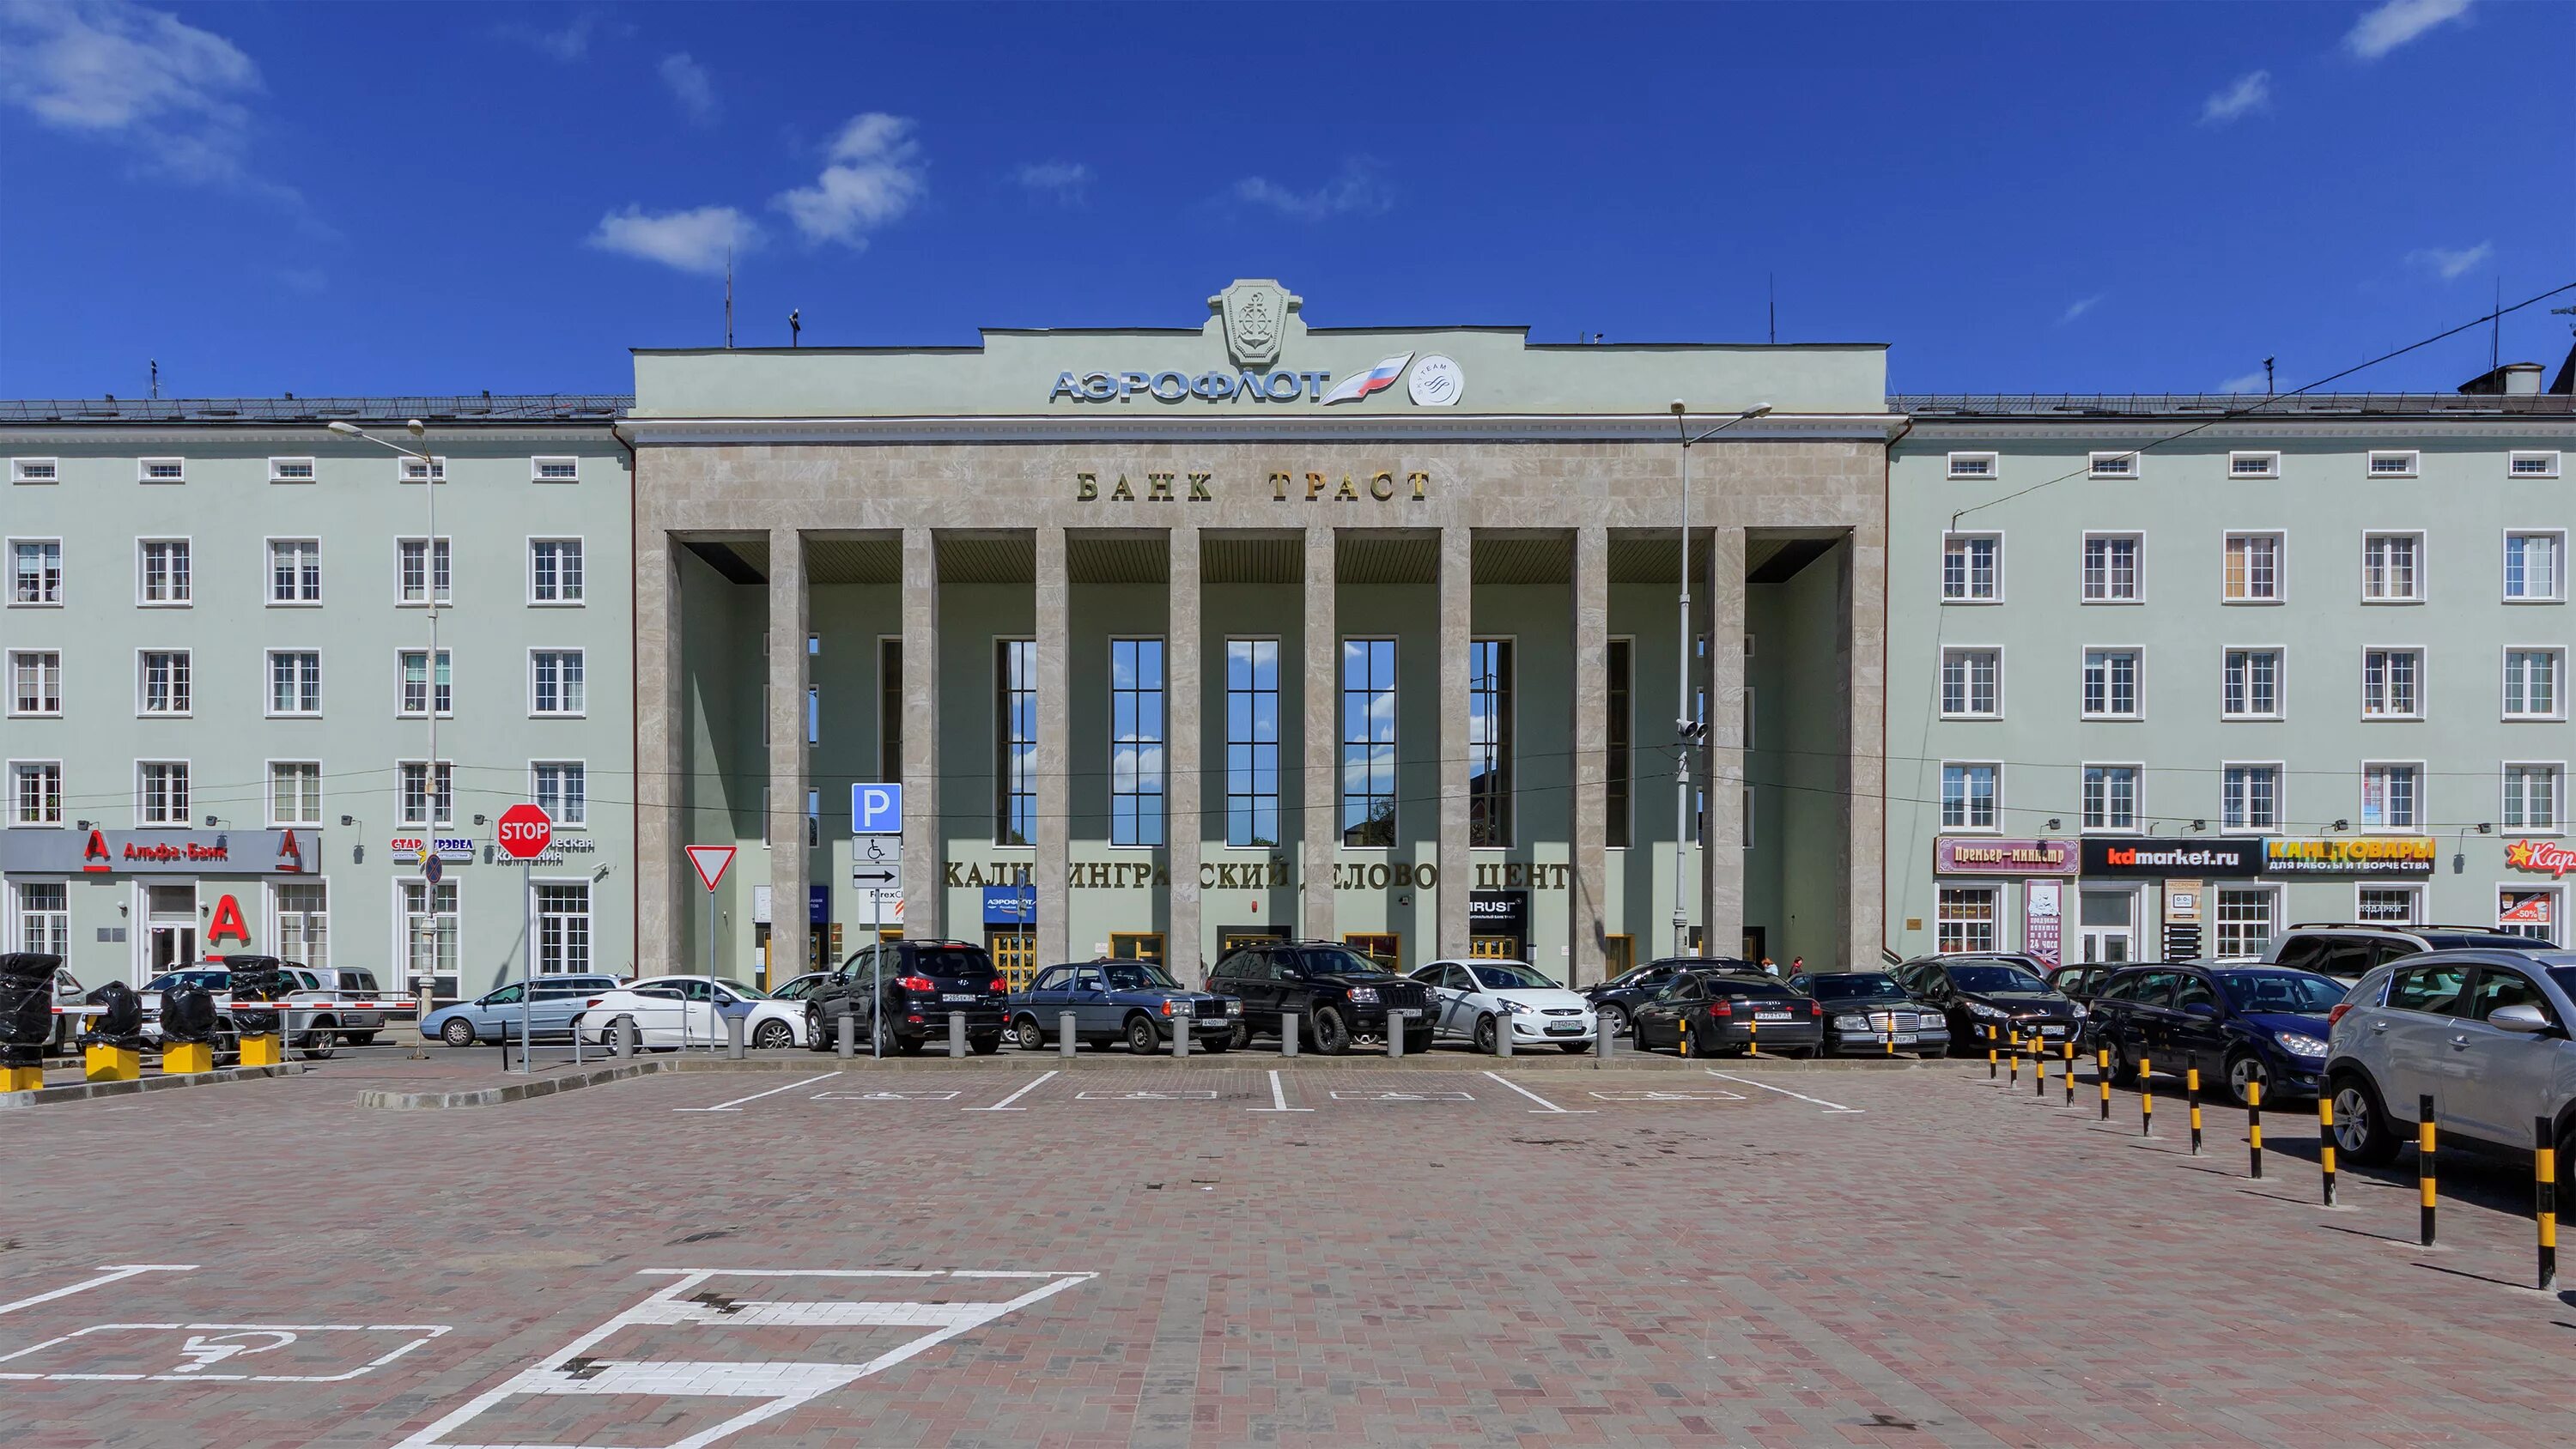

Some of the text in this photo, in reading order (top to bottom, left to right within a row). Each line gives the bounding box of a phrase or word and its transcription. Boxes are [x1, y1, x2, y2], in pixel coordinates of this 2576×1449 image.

[1049, 371, 1331, 403] АЭРОФЛОТ
[1077, 472, 1430, 501] БАНК ТРАСТ
[864, 790, 890, 827] P
[501, 822, 549, 840] STOP
[392, 840, 422, 849] СТАР
[2269, 841, 2435, 860] КАНЦТОВАРЫ
[2108, 848, 2239, 865] kdmarket.ru
[2529, 844, 2576, 874] Кар
[2030, 939, 2039, 949] 24
